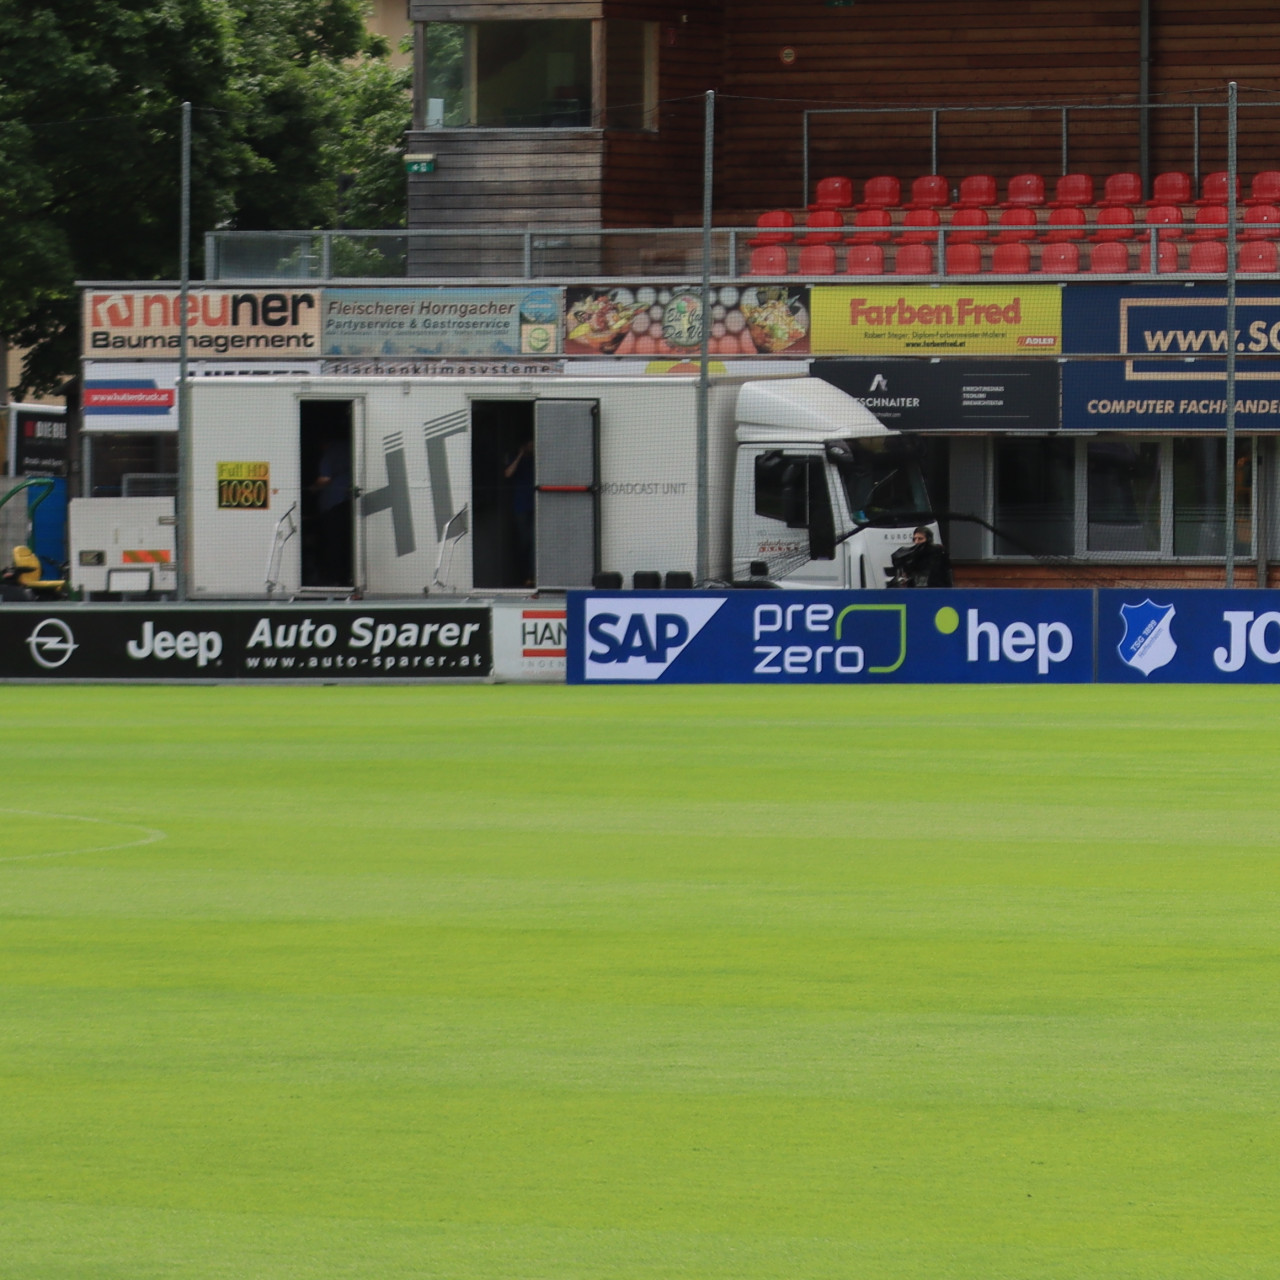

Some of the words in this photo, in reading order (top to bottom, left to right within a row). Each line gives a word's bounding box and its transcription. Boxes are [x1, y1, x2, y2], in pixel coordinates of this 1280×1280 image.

[143, 293, 315, 327] neuner
[328, 300, 416, 315] Fleischerei
[420, 300, 516, 318] Horngacher
[326, 319, 405, 331] Partyservice
[410, 319, 418, 329] &
[424, 319, 511, 330] Gastroservice
[91, 331, 315, 353] Baumanagement
[1025, 337, 1055, 345] ADLER
[856, 397, 920, 407] SCHNAITER
[1087, 399, 1176, 415] COMPUTER
[220, 480, 267, 506] 1080
[662, 482, 688, 495] UNIT
[753, 603, 834, 641] pre
[127, 621, 223, 666] Jeep
[247, 618, 324, 649] Auto
[334, 618, 480, 654] Sparer
[588, 612, 690, 664] SAP
[967, 609, 1074, 675] hep
[1130, 635, 1145, 652] TSG
[246, 654, 483, 672] www.auto-sparer.at
[753, 644, 864, 674] zero
